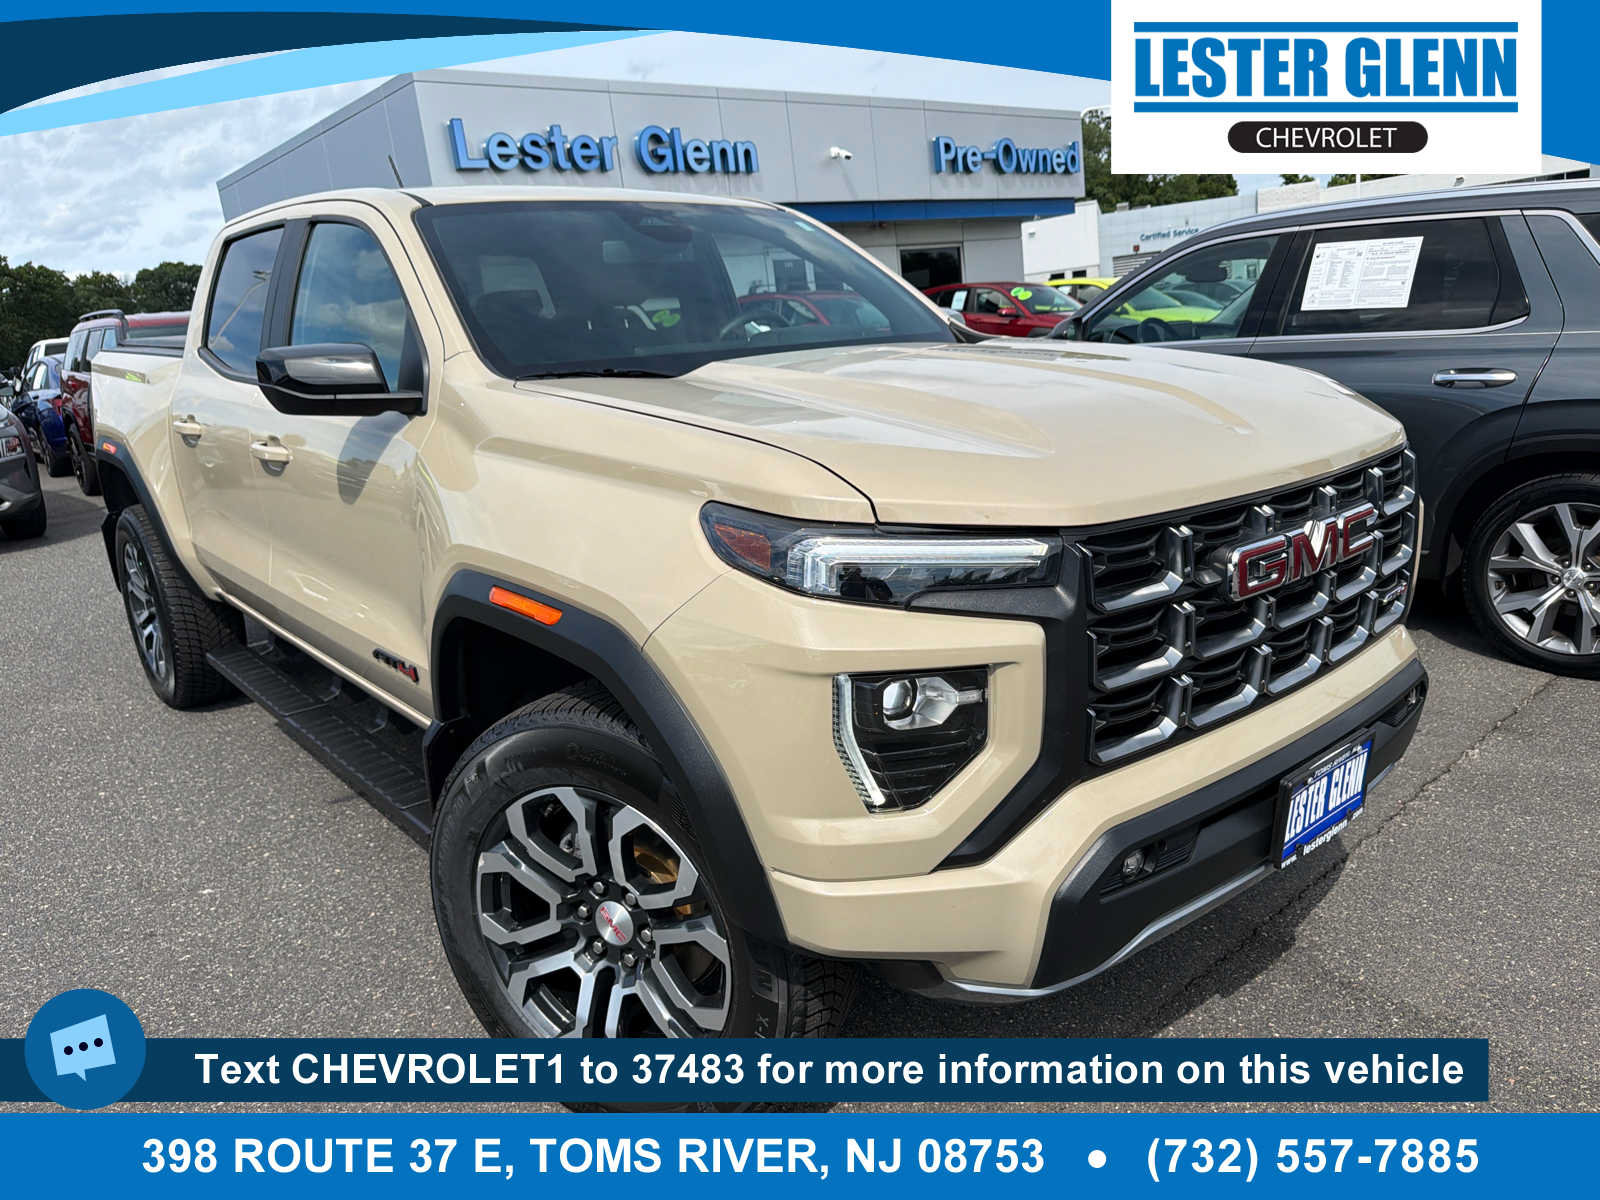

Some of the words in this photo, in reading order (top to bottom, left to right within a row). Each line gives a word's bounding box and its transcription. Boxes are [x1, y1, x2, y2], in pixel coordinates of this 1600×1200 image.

[449, 118, 618, 171] Lester
[637, 125, 760, 172] Glenn
[934, 136, 1080, 174] Pre-Owned
[1140, 230, 1170, 241] Certified
[1173, 227, 1199, 237] Service
[1231, 502, 1378, 600] GMC
[1284, 775, 1328, 844] LESTER
[1328, 752, 1368, 811] GLENN
[600, 906, 626, 942] GMC
